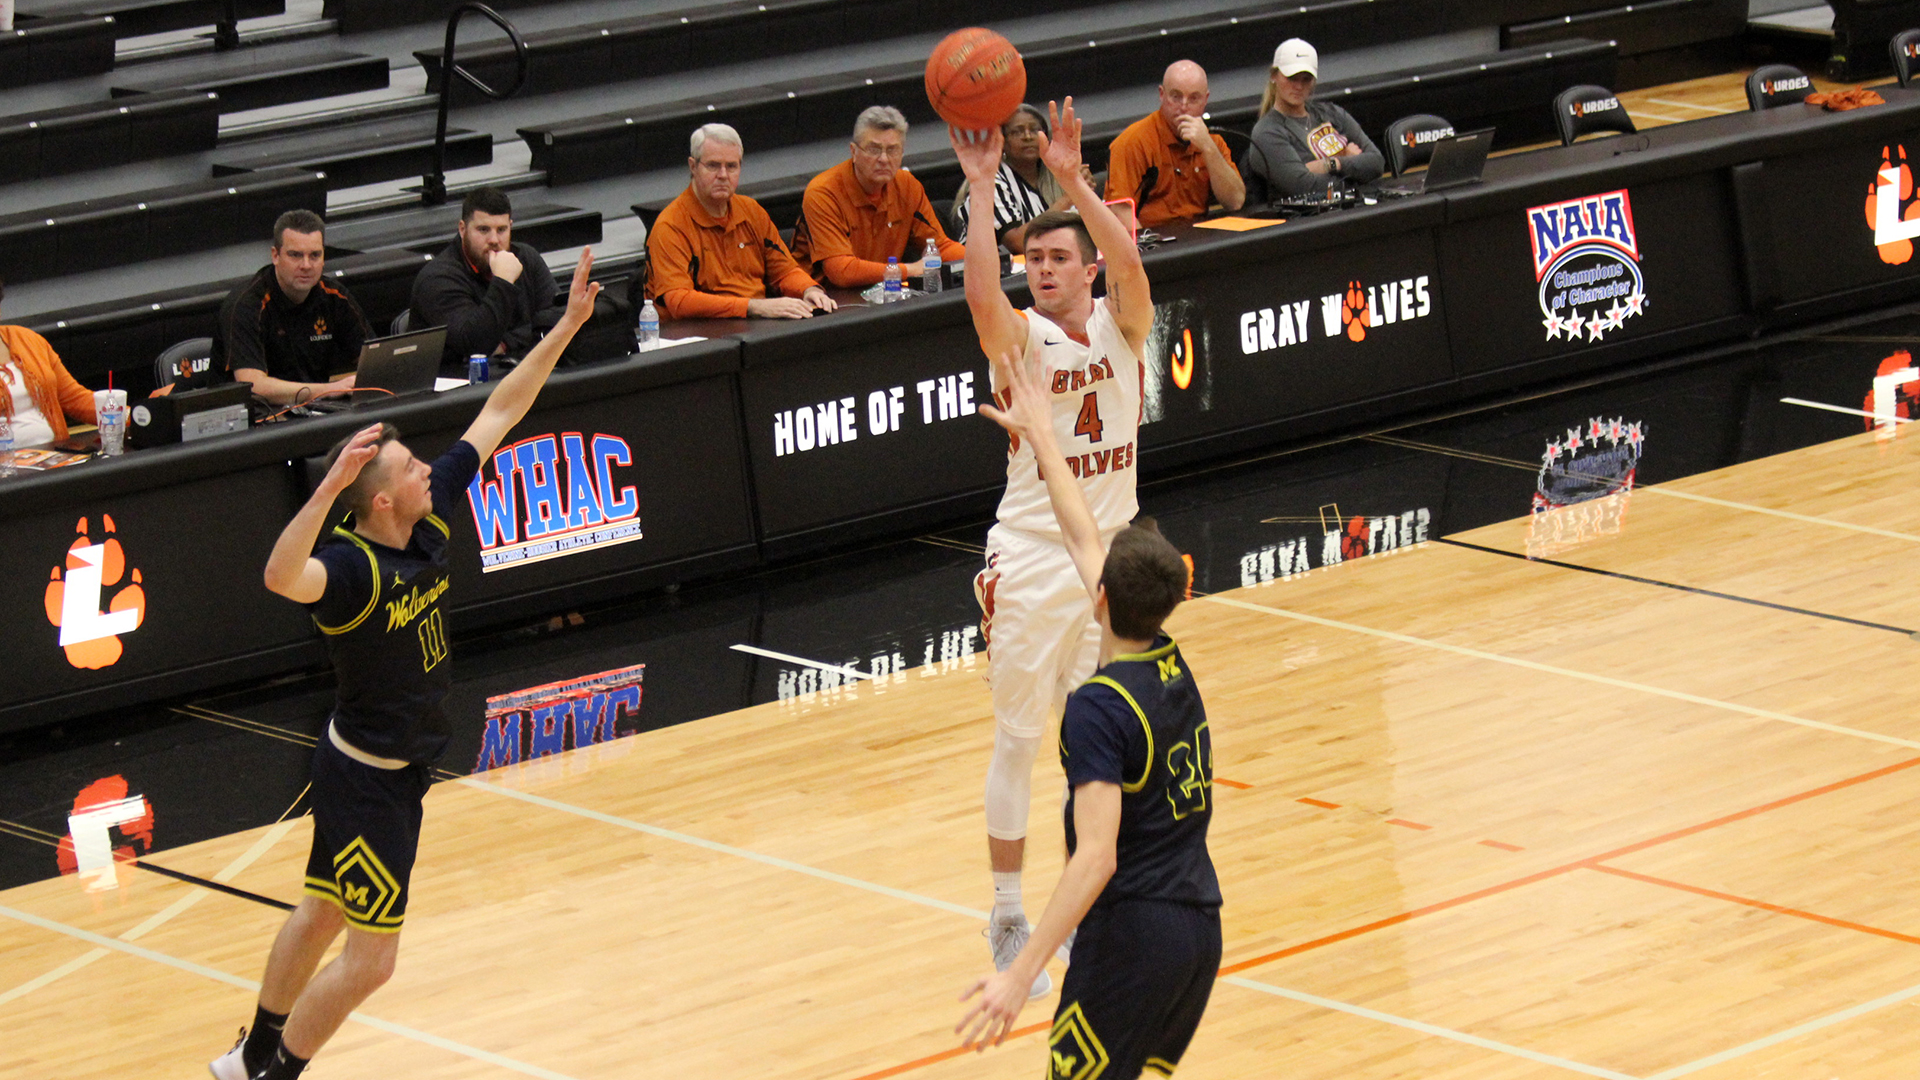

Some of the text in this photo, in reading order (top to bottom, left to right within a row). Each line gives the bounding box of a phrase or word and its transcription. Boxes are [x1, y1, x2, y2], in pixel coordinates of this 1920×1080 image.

[1529, 193, 1636, 272] NAIA
[1552, 280, 1631, 310] of Character
[1554, 263, 1624, 289] Champions
[1240, 300, 1310, 355] GRAY
[1051, 354, 1115, 394] GRAY
[774, 371, 976, 457] HOME OF THE
[1074, 391, 1103, 443] 4
[1034, 441, 1134, 481] OLVES
[466, 432, 640, 550] WHAC
[59, 543, 138, 646] L
[418, 607, 448, 673] 11
[1157, 654, 1182, 682] M
[345, 881, 370, 906] M
